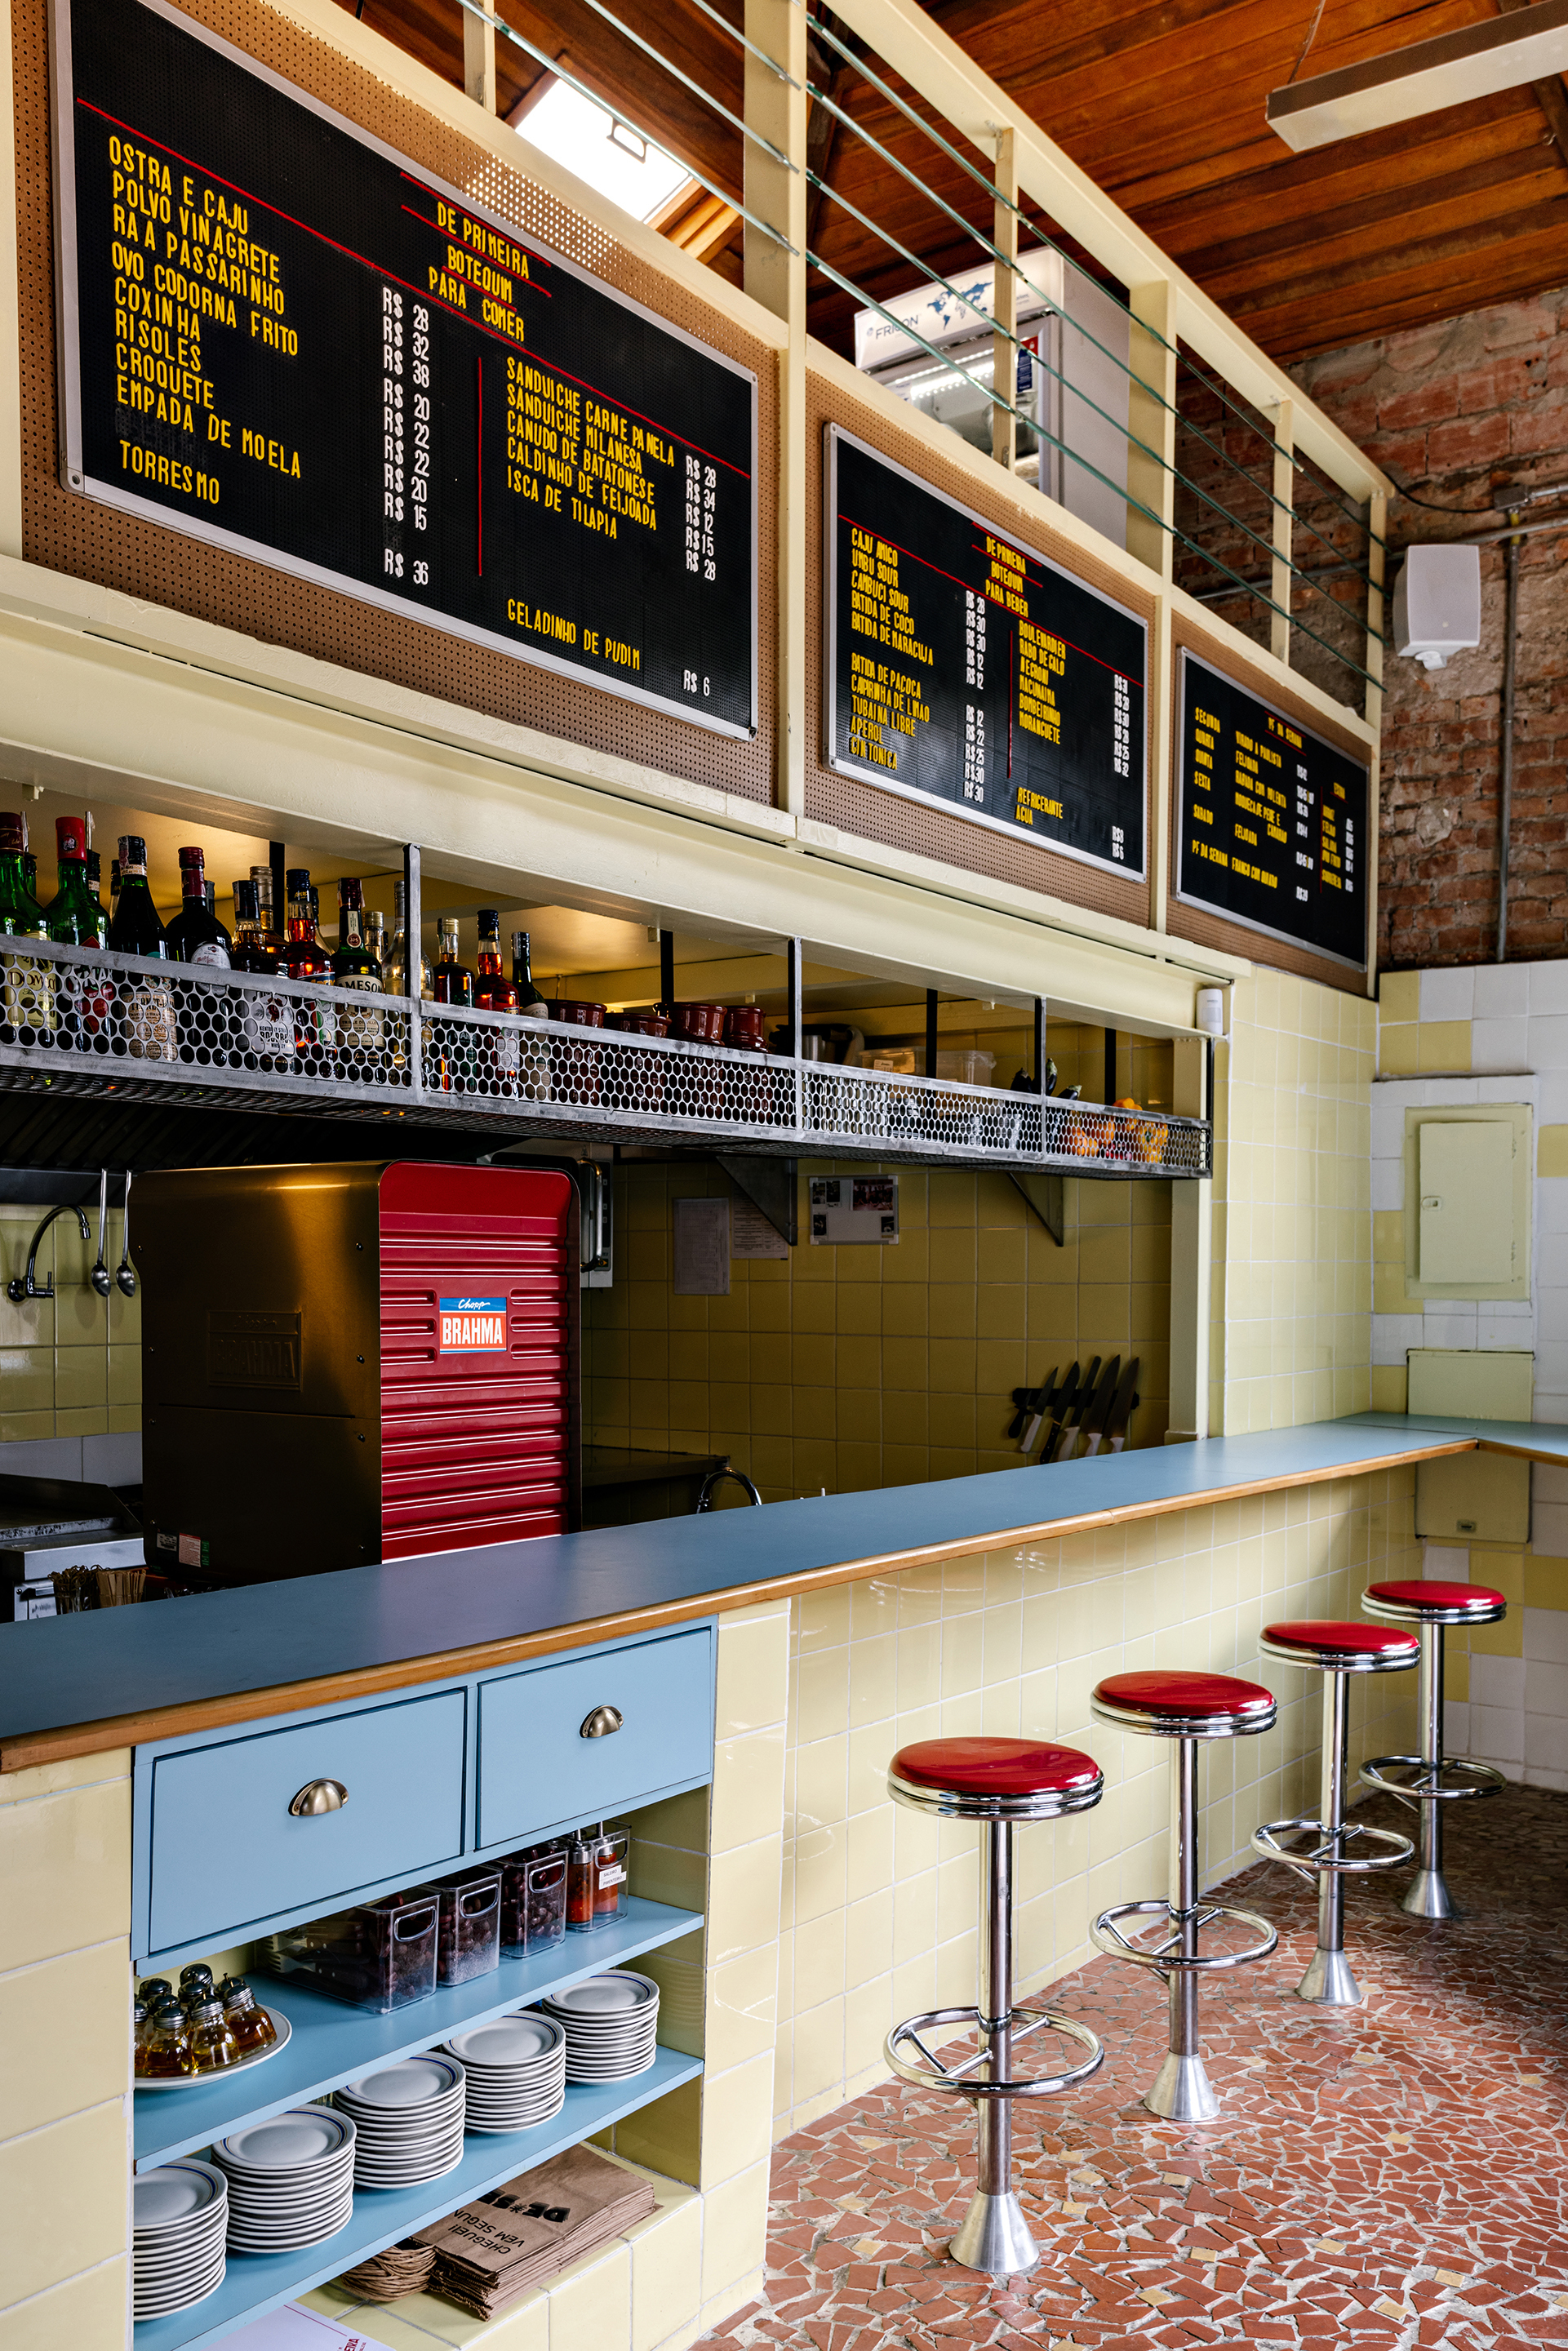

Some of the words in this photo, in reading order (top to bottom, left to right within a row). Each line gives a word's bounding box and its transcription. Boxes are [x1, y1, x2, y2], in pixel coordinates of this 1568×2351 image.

[109, 136, 171, 195] OSTRA
[183, 176, 194, 207] E
[204, 189, 247, 235] CAJU
[113, 170, 171, 224] POLVO
[179, 207, 279, 283] VINAGRETE
[438, 202, 456, 234] DE
[463, 218, 529, 279] PRIMEIRA
[113, 203, 138, 242] RA
[144, 220, 156, 251] A
[167, 231, 284, 315] PASSARINHO
[447, 245, 512, 304] BOTEQUIM
[112, 242, 144, 281] OVO
[154, 264, 237, 328] CODORNA
[251, 311, 297, 356] FRITO
[115, 277, 200, 341] COXINHA
[383, 287, 402, 318] R$
[413, 304, 429, 331] 28
[429, 266, 466, 309] PARA
[482, 298, 524, 342] COMER
[116, 309, 201, 372] RISOLES
[384, 316, 402, 347] R$
[413, 332, 429, 361] 32
[116, 343, 214, 410] CROQUETE
[384, 344, 402, 375] R$
[413, 360, 429, 388] 38
[384, 378, 403, 408] R$
[415, 393, 429, 420] 20
[507, 357, 580, 412] SANDUICHE
[586, 401, 627, 441] CARNE
[633, 426, 674, 467] PANELA
[117, 374, 193, 433] EMPADA
[208, 414, 231, 448] DE
[242, 429, 300, 478] MOELA
[384, 407, 403, 437] R$
[415, 422, 429, 449] 22
[507, 384, 580, 441] SANDUICHE
[586, 424, 642, 473] MILANESA
[120, 440, 219, 504] TORRESMO
[384, 435, 403, 464] R$
[415, 450, 429, 477] 22
[508, 410, 557, 453] CANUDO
[562, 437, 578, 465] DE
[584, 449, 655, 504] BATATONESE
[686, 456, 700, 480] R$
[705, 466, 716, 488] 28
[384, 463, 403, 493] R$
[411, 476, 427, 502] 20
[508, 437, 572, 487] CALDINHO
[578, 471, 593, 498] DE
[600, 478, 656, 531] FEIJOADA
[508, 465, 539, 502] ISCA
[544, 485, 562, 512] DE
[571, 497, 616, 539] TILAPIA
[686, 479, 700, 504] R$
[704, 489, 715, 511] 34
[384, 492, 403, 521] R$
[414, 504, 427, 530] 15
[686, 503, 700, 527] R$
[704, 512, 713, 534] 12
[852, 528, 873, 553] CAJU
[385, 549, 403, 577] R$
[414, 561, 429, 584] 36
[686, 550, 699, 572] R$
[704, 559, 715, 580] 28
[852, 549, 874, 576] UMBU
[877, 562, 898, 588] SOUR
[851, 570, 886, 602] CAMBUCI
[889, 589, 908, 614] SOUR
[852, 590, 877, 619] BATIDA
[880, 604, 891, 624] DE
[894, 611, 914, 634] COCO
[985, 580, 1004, 604] PARA
[1006, 591, 1028, 617] BEBER
[508, 599, 575, 644] GELADINHO
[584, 629, 598, 655] DE
[605, 638, 639, 670] PUDIM
[851, 611, 877, 639] BATIDA
[880, 624, 891, 645] DE
[892, 630, 933, 665] MARACUJA
[684, 670, 697, 693] R$
[704, 677, 709, 696] 6
[851, 652, 875, 679] BATIDA
[877, 664, 888, 685] DE
[891, 711, 916, 736] LIBRE
[894, 691, 904, 712] DE
[908, 698, 930, 722] LIMAO
[851, 716, 883, 744] APEROL
[868, 743, 896, 770] TONICA
[458, 1298, 491, 1310] Chopp
[442, 1318, 503, 1344] BRAHMA
[448, 2224, 512, 2255] CHEGUEI!
[494, 2231, 525, 2248] VEM
